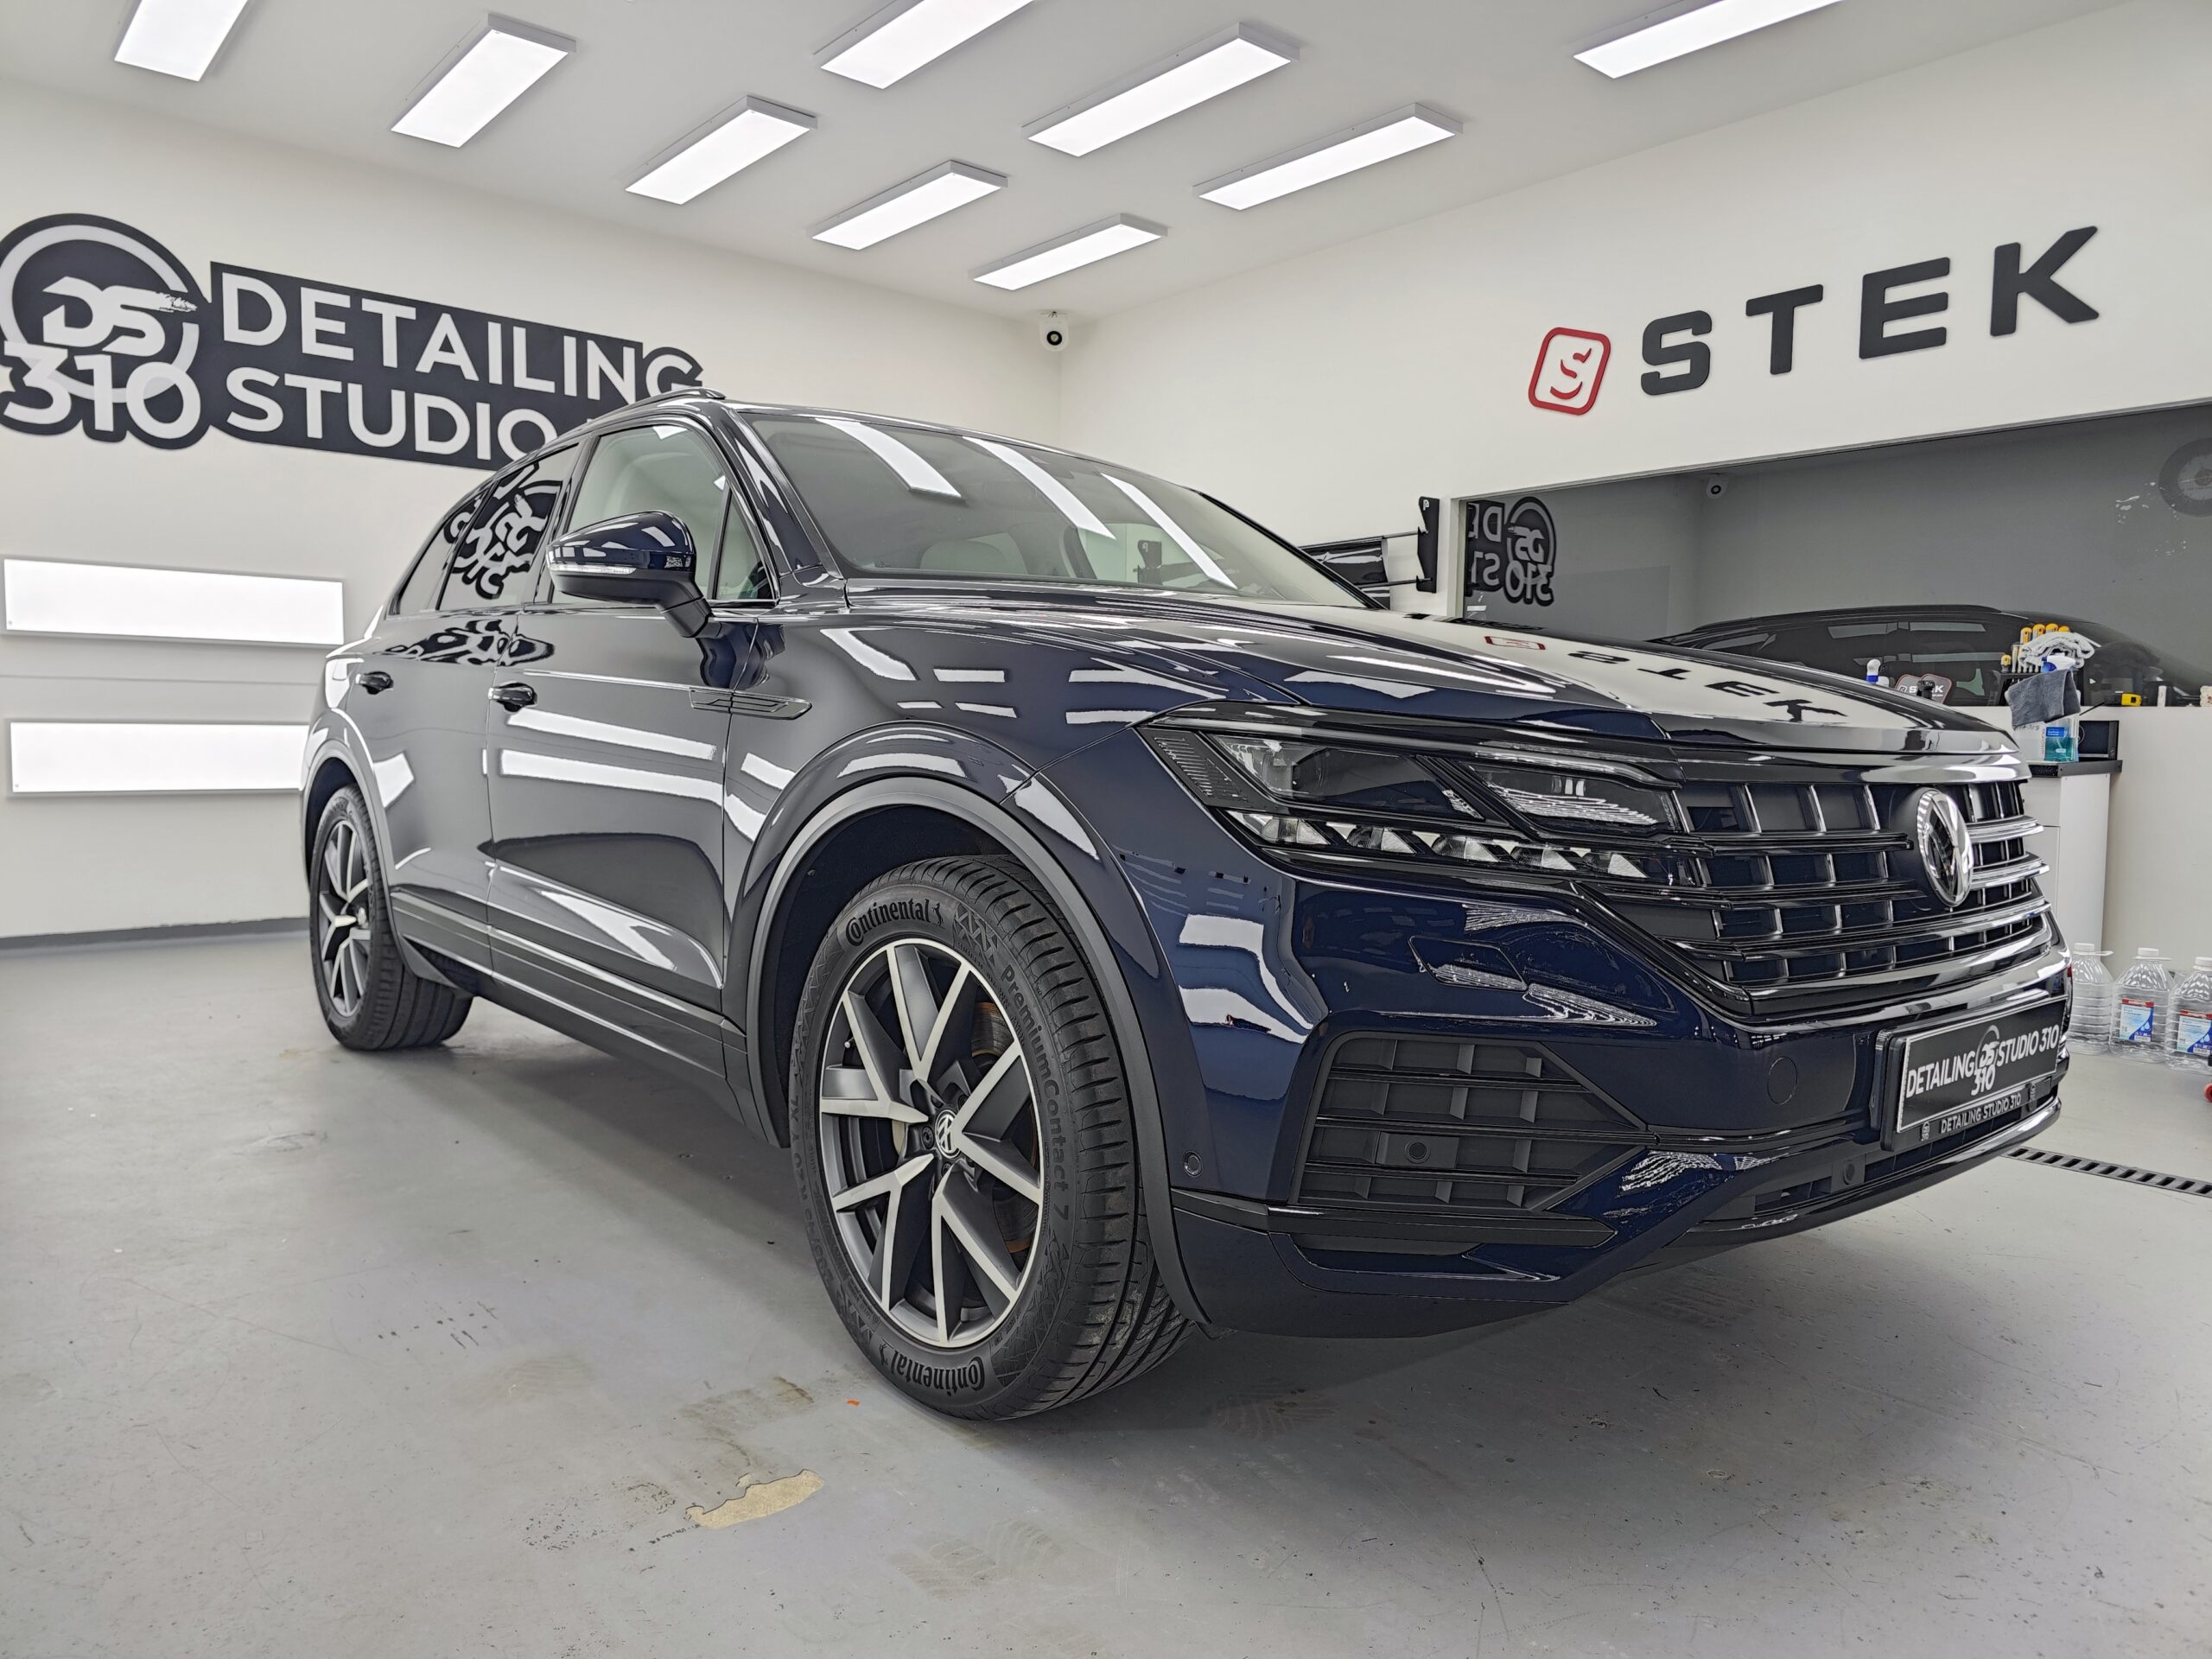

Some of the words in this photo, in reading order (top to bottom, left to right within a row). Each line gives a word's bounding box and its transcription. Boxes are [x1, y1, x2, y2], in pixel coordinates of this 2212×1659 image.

[221, 271, 698, 406] DETAILING
[1640, 225, 2100, 397] STEK
[3, 340, 201, 440] 310
[226, 365, 558, 461] STUDIO
[845, 898, 931, 947] Continental
[1905, 1050, 1976, 1098] DETAILING
[1996, 1030, 2039, 1067] STUDIO
[2038, 1024, 2060, 1053] 310
[1971, 1064, 1996, 1096] 310
[1940, 1109, 1982, 1134] DETAILING
[1983, 1098, 2010, 1119] STUDIO
[2010, 1093, 2022, 1109] 310
[1053, 1205, 1069, 1221] 7
[890, 1349, 985, 1396] Continental
